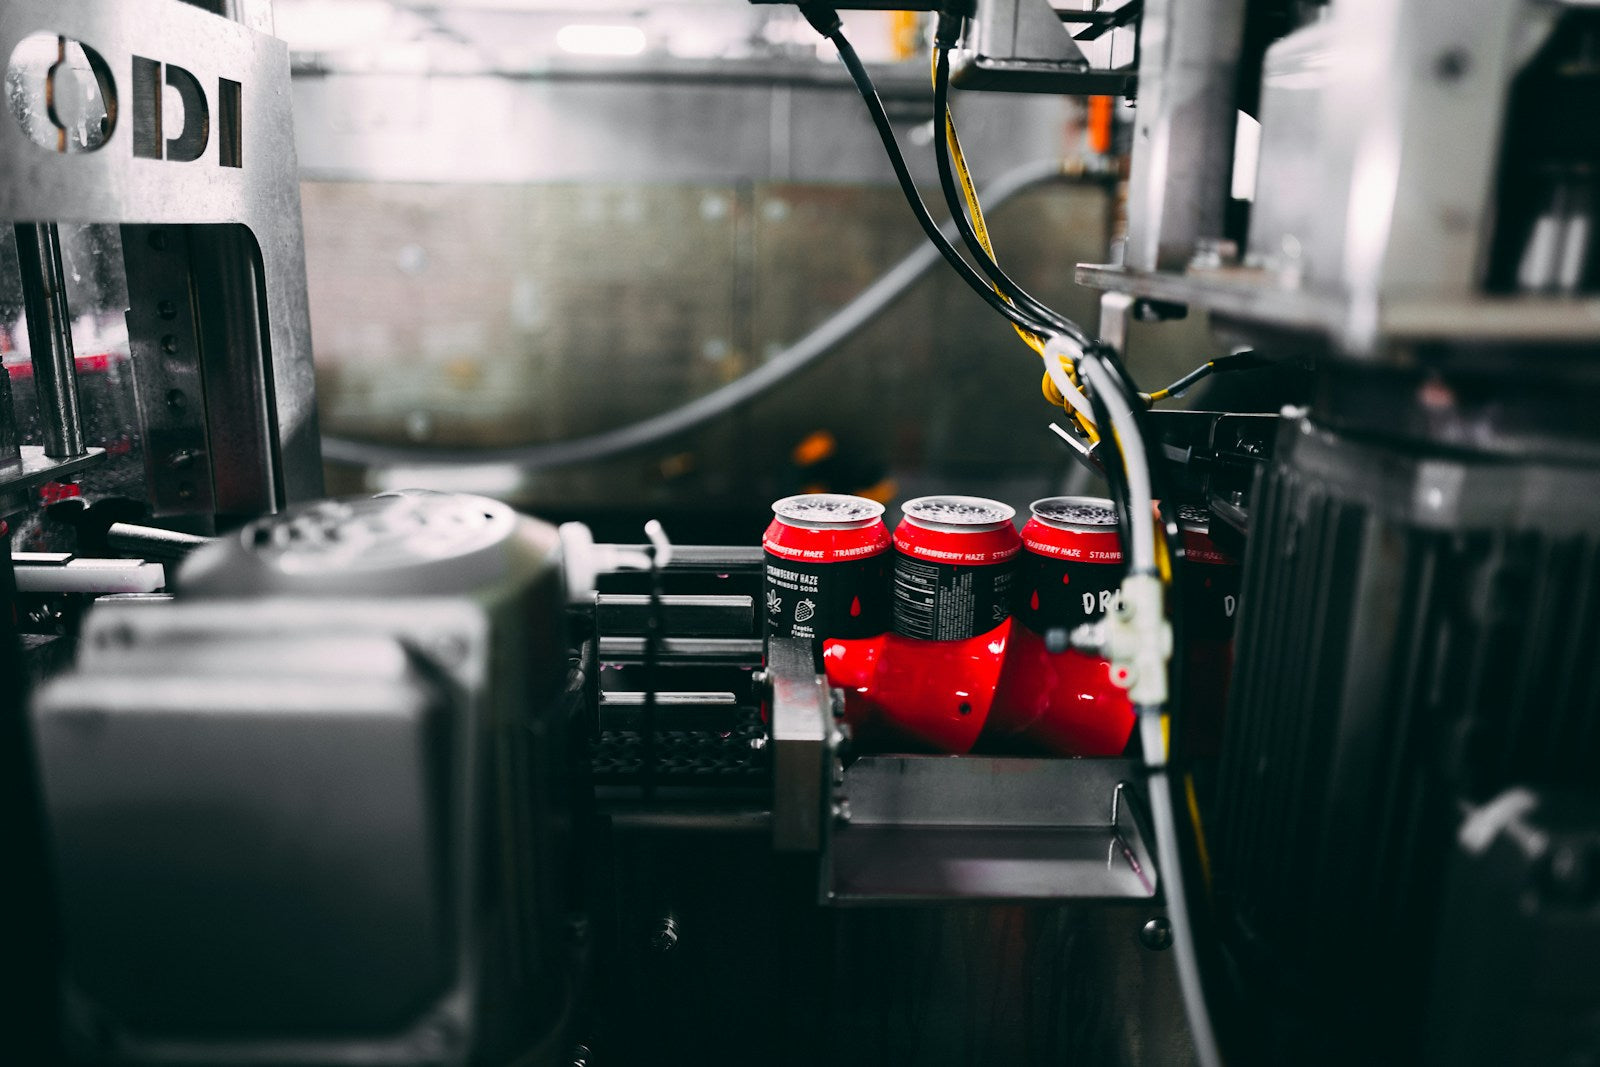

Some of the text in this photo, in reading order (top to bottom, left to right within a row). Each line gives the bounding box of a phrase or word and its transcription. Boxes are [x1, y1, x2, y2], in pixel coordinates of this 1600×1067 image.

[4, 30, 243, 168] ODI
[914, 546, 985, 561] STRAWBERRY HAZE
[1026, 539, 1081, 558] RAWBERRY HAZE
[803, 550, 825, 559] HAZE
[1089, 551, 1123, 560] STRAWB
[800, 574, 818, 585] HAZE
[799, 585, 818, 593] SODA
